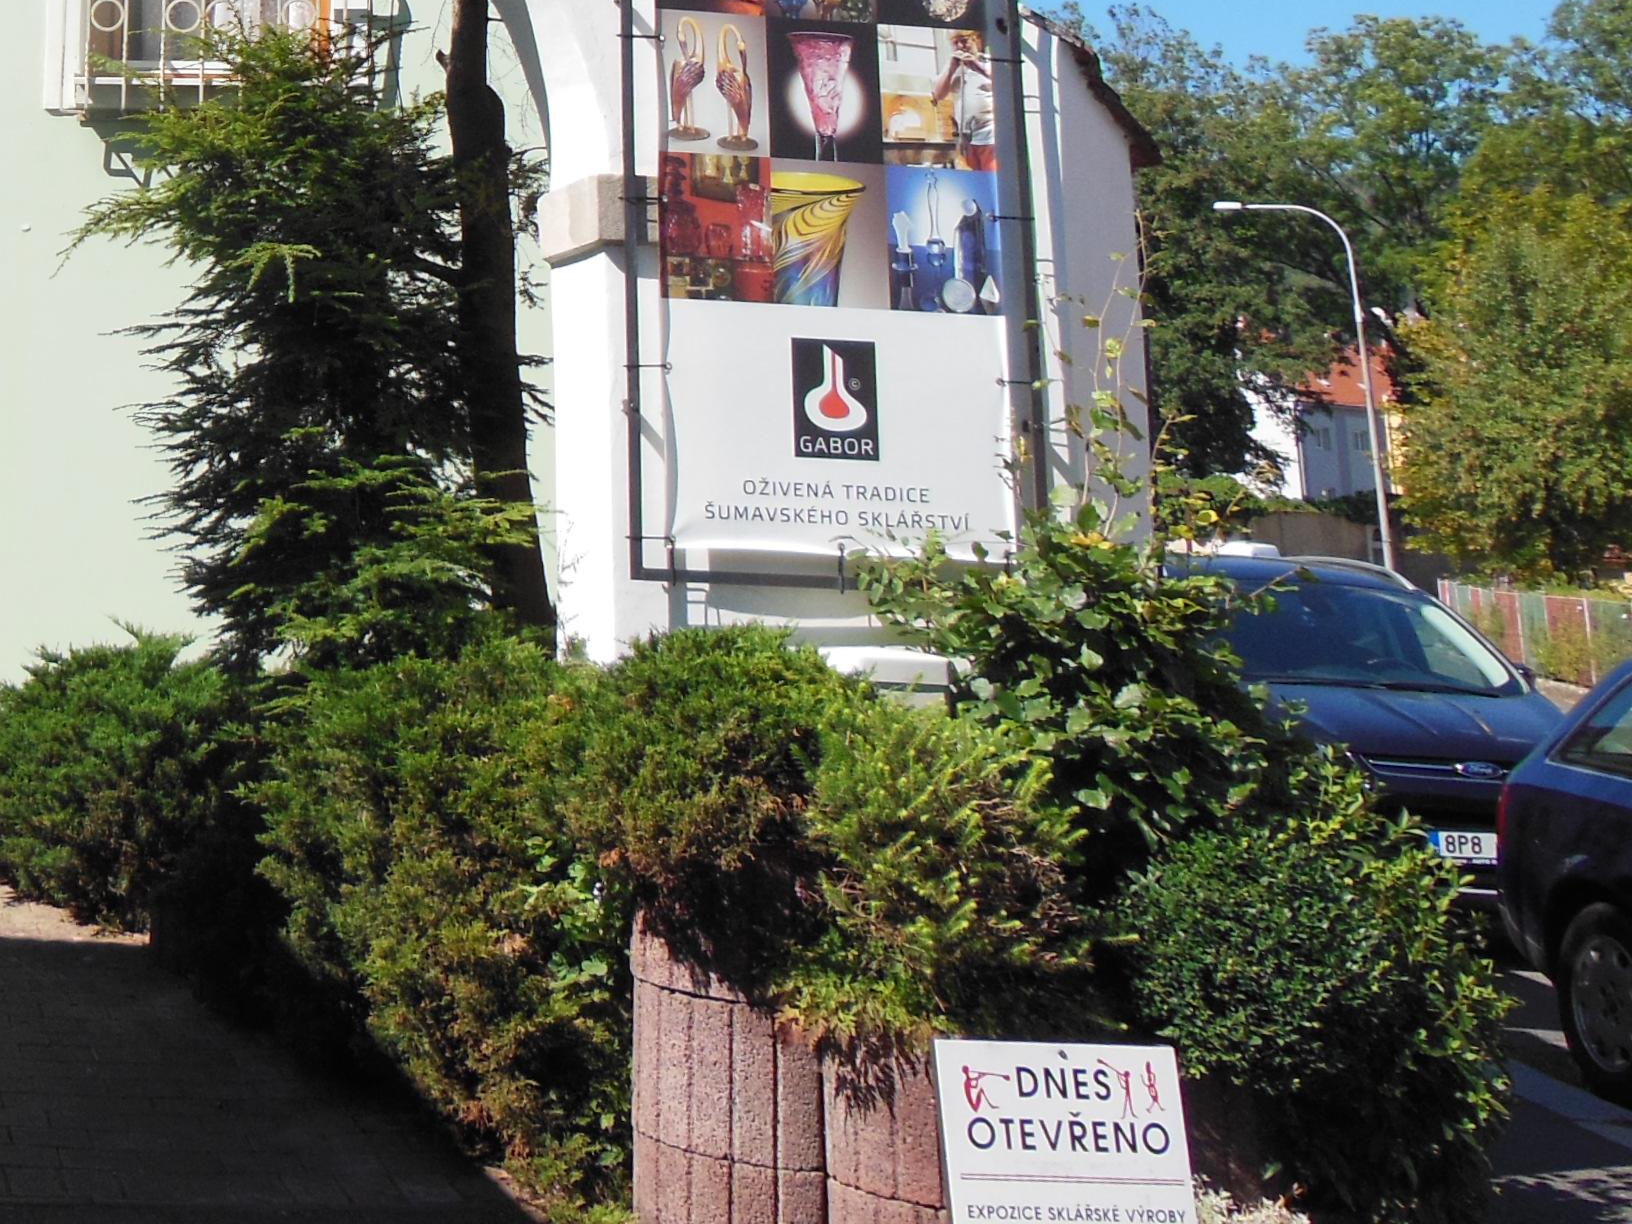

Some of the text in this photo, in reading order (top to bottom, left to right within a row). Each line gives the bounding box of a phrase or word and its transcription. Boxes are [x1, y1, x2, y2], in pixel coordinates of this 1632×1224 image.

[800, 436, 874, 455] GABOR
[743, 477, 930, 503] OŽIVENÁ TRADICE
[705, 501, 969, 531] ŠUMAVSKÉHO SKLÁŘSTVÍ
[1445, 834, 1482, 854] 8P8
[1016, 1066, 1111, 1101] DNES
[967, 1112, 1170, 1155] OTEVŘENO
[968, 1204, 1186, 1223] EXPOZICE SKLÁŘSKÉ VÝROBY
